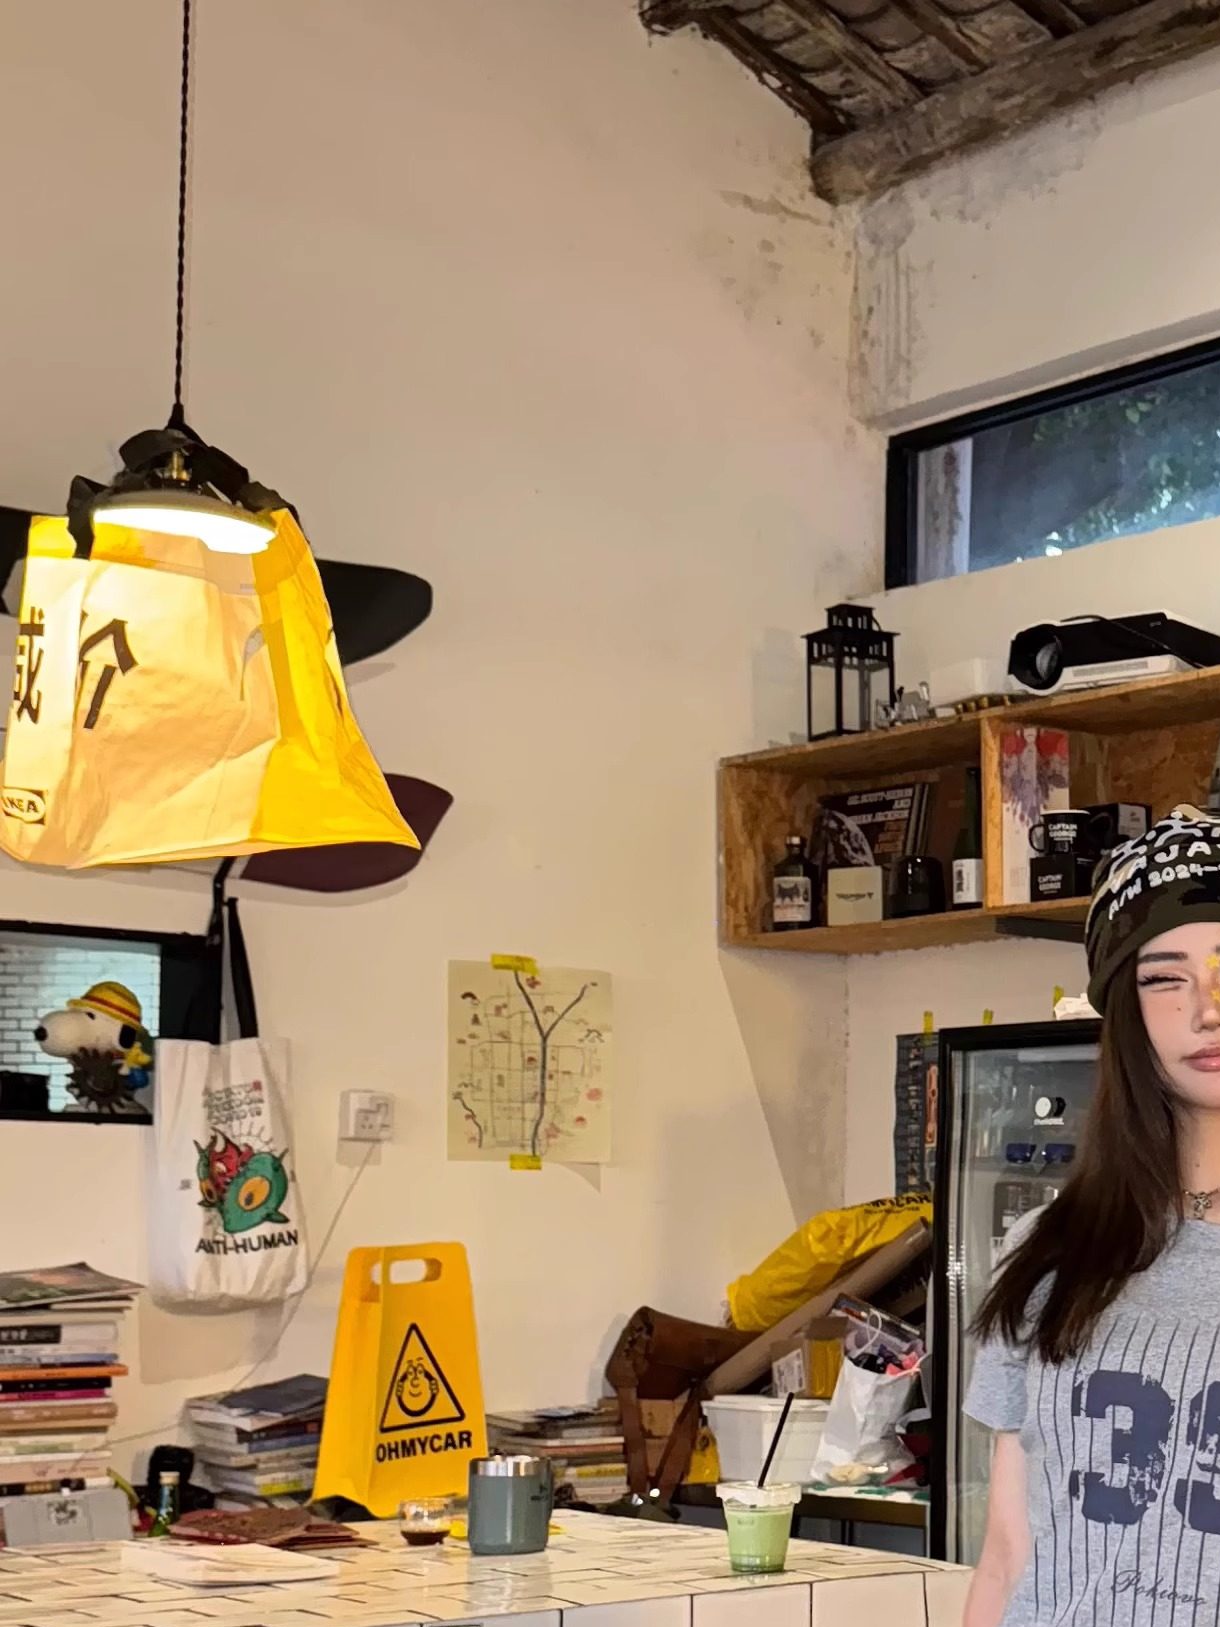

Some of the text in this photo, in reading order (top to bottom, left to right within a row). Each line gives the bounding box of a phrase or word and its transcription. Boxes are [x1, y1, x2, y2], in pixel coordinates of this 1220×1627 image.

[1109, 877, 1142, 921] A/W
[195, 1229, 298, 1256] ANTI-HUMAN
[375, 1431, 472, 1463] OHMYCAR
